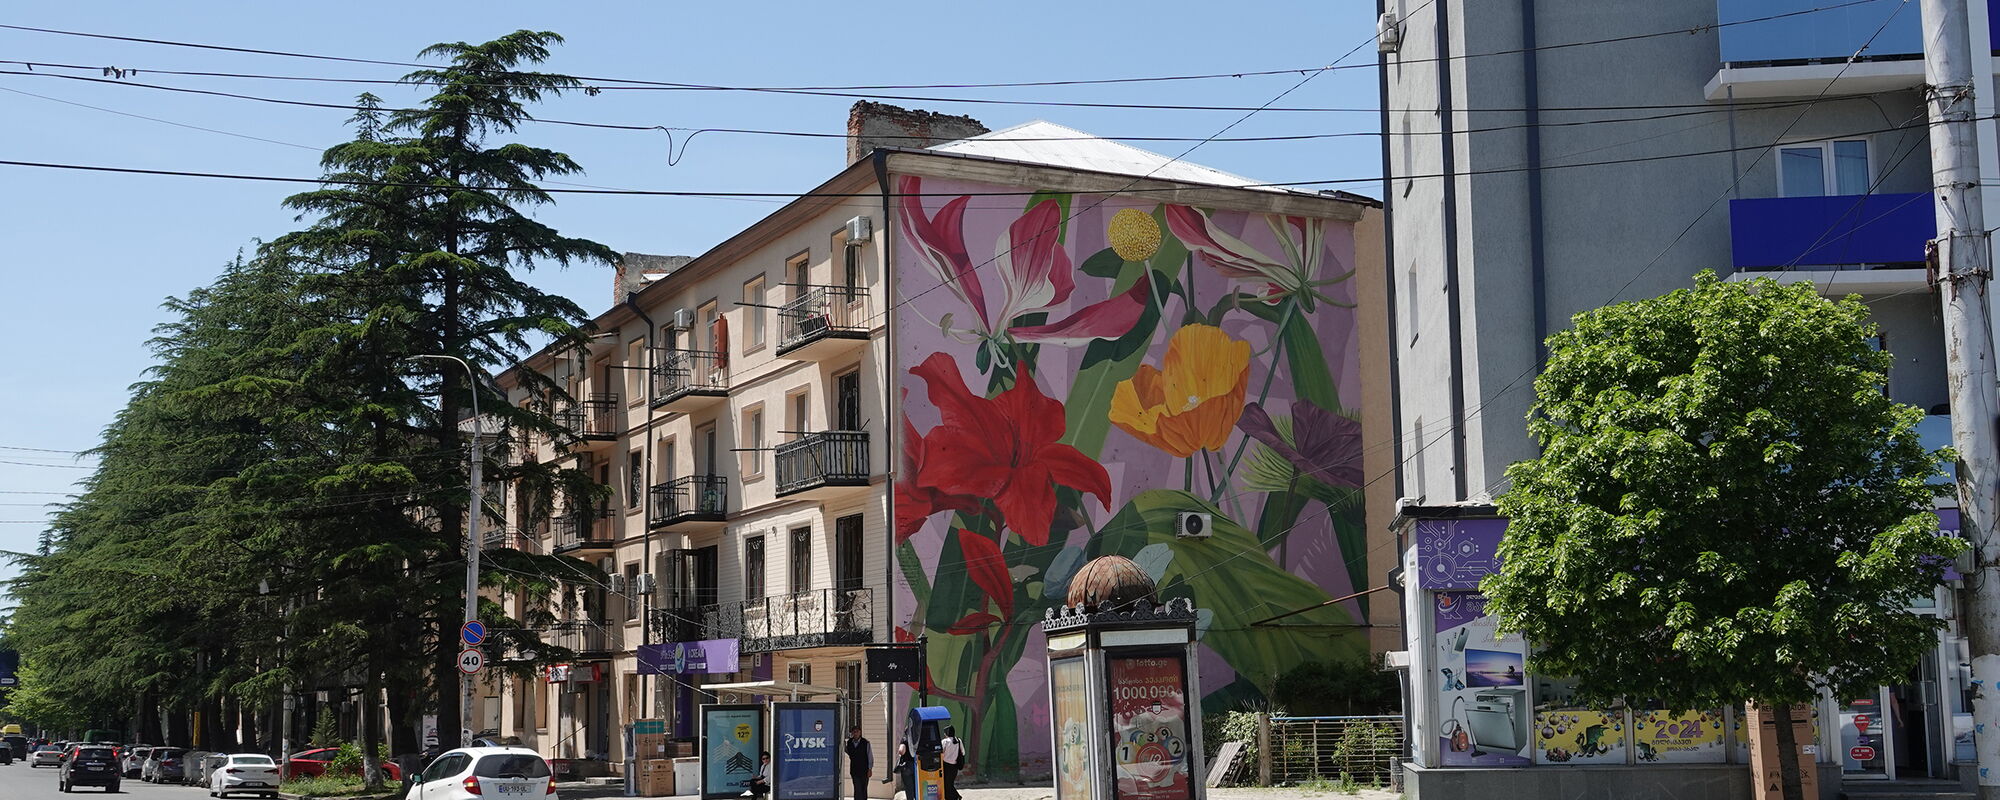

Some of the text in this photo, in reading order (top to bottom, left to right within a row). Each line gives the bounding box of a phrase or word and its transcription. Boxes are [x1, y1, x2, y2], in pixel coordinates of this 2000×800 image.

[462, 656, 479, 666] 40
[1136, 659, 1168, 668] lotto.ge
[1147, 733, 1155, 742] 3
[1161, 729, 1169, 739] 9
[793, 737, 826, 748] JYSK
[1172, 741, 1181, 754] 2
[1122, 747, 1129, 761] 1
